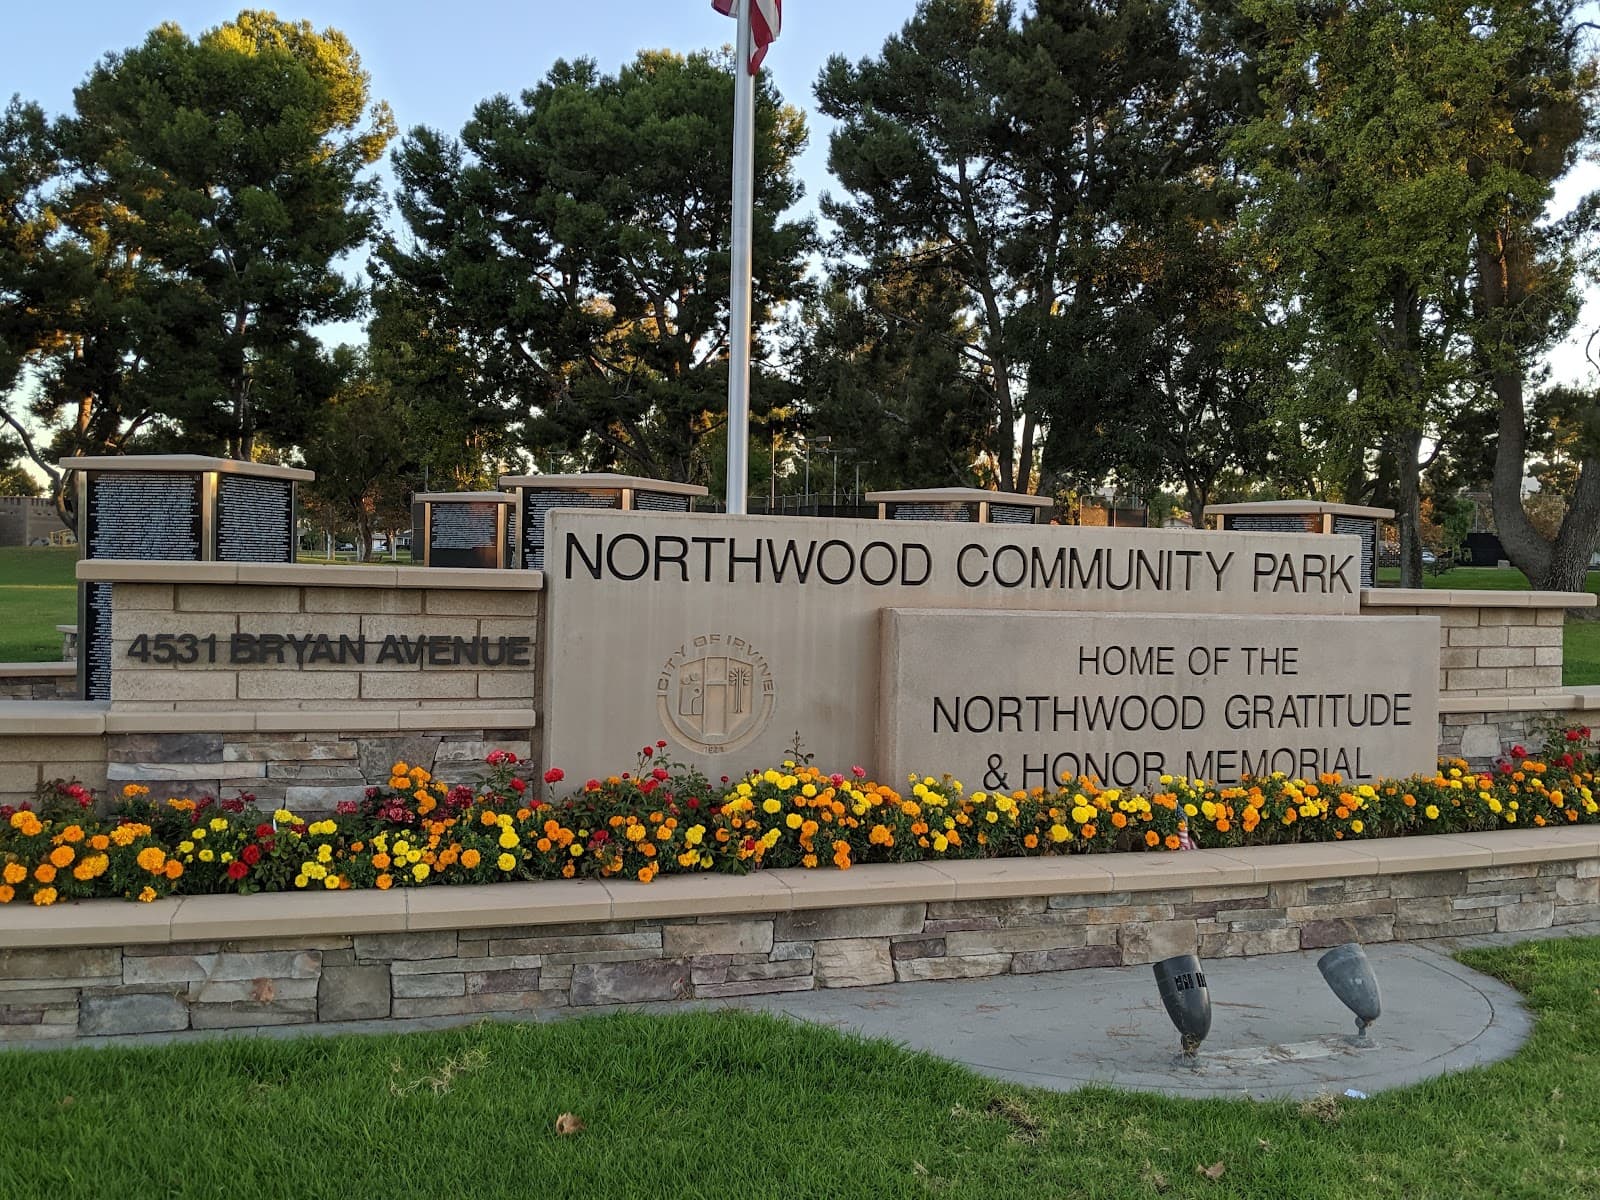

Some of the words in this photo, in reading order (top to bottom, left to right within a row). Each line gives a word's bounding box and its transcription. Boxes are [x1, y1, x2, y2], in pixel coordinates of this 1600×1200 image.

[564, 532, 932, 587] NORTHWOOD
[956, 543, 1234, 591] COMMUNITY
[1253, 552, 1355, 595] PARK
[127, 633, 216, 664] 4531
[231, 633, 366, 665] BRYAN
[376, 635, 530, 666] AVENUE
[656, 644, 687, 691] CITY
[693, 633, 721, 648] OF
[726, 634, 774, 692] IRVINE
[1079, 645, 1174, 676] HOME
[1188, 646, 1230, 676] OF
[1241, 647, 1299, 675] THE
[933, 695, 1206, 733] NORTHWOOD
[1224, 694, 1412, 729] GRATITUDE
[982, 753, 1010, 791] &
[1022, 751, 1166, 789] HONOR
[1186, 746, 1373, 785] MEMORIAL
